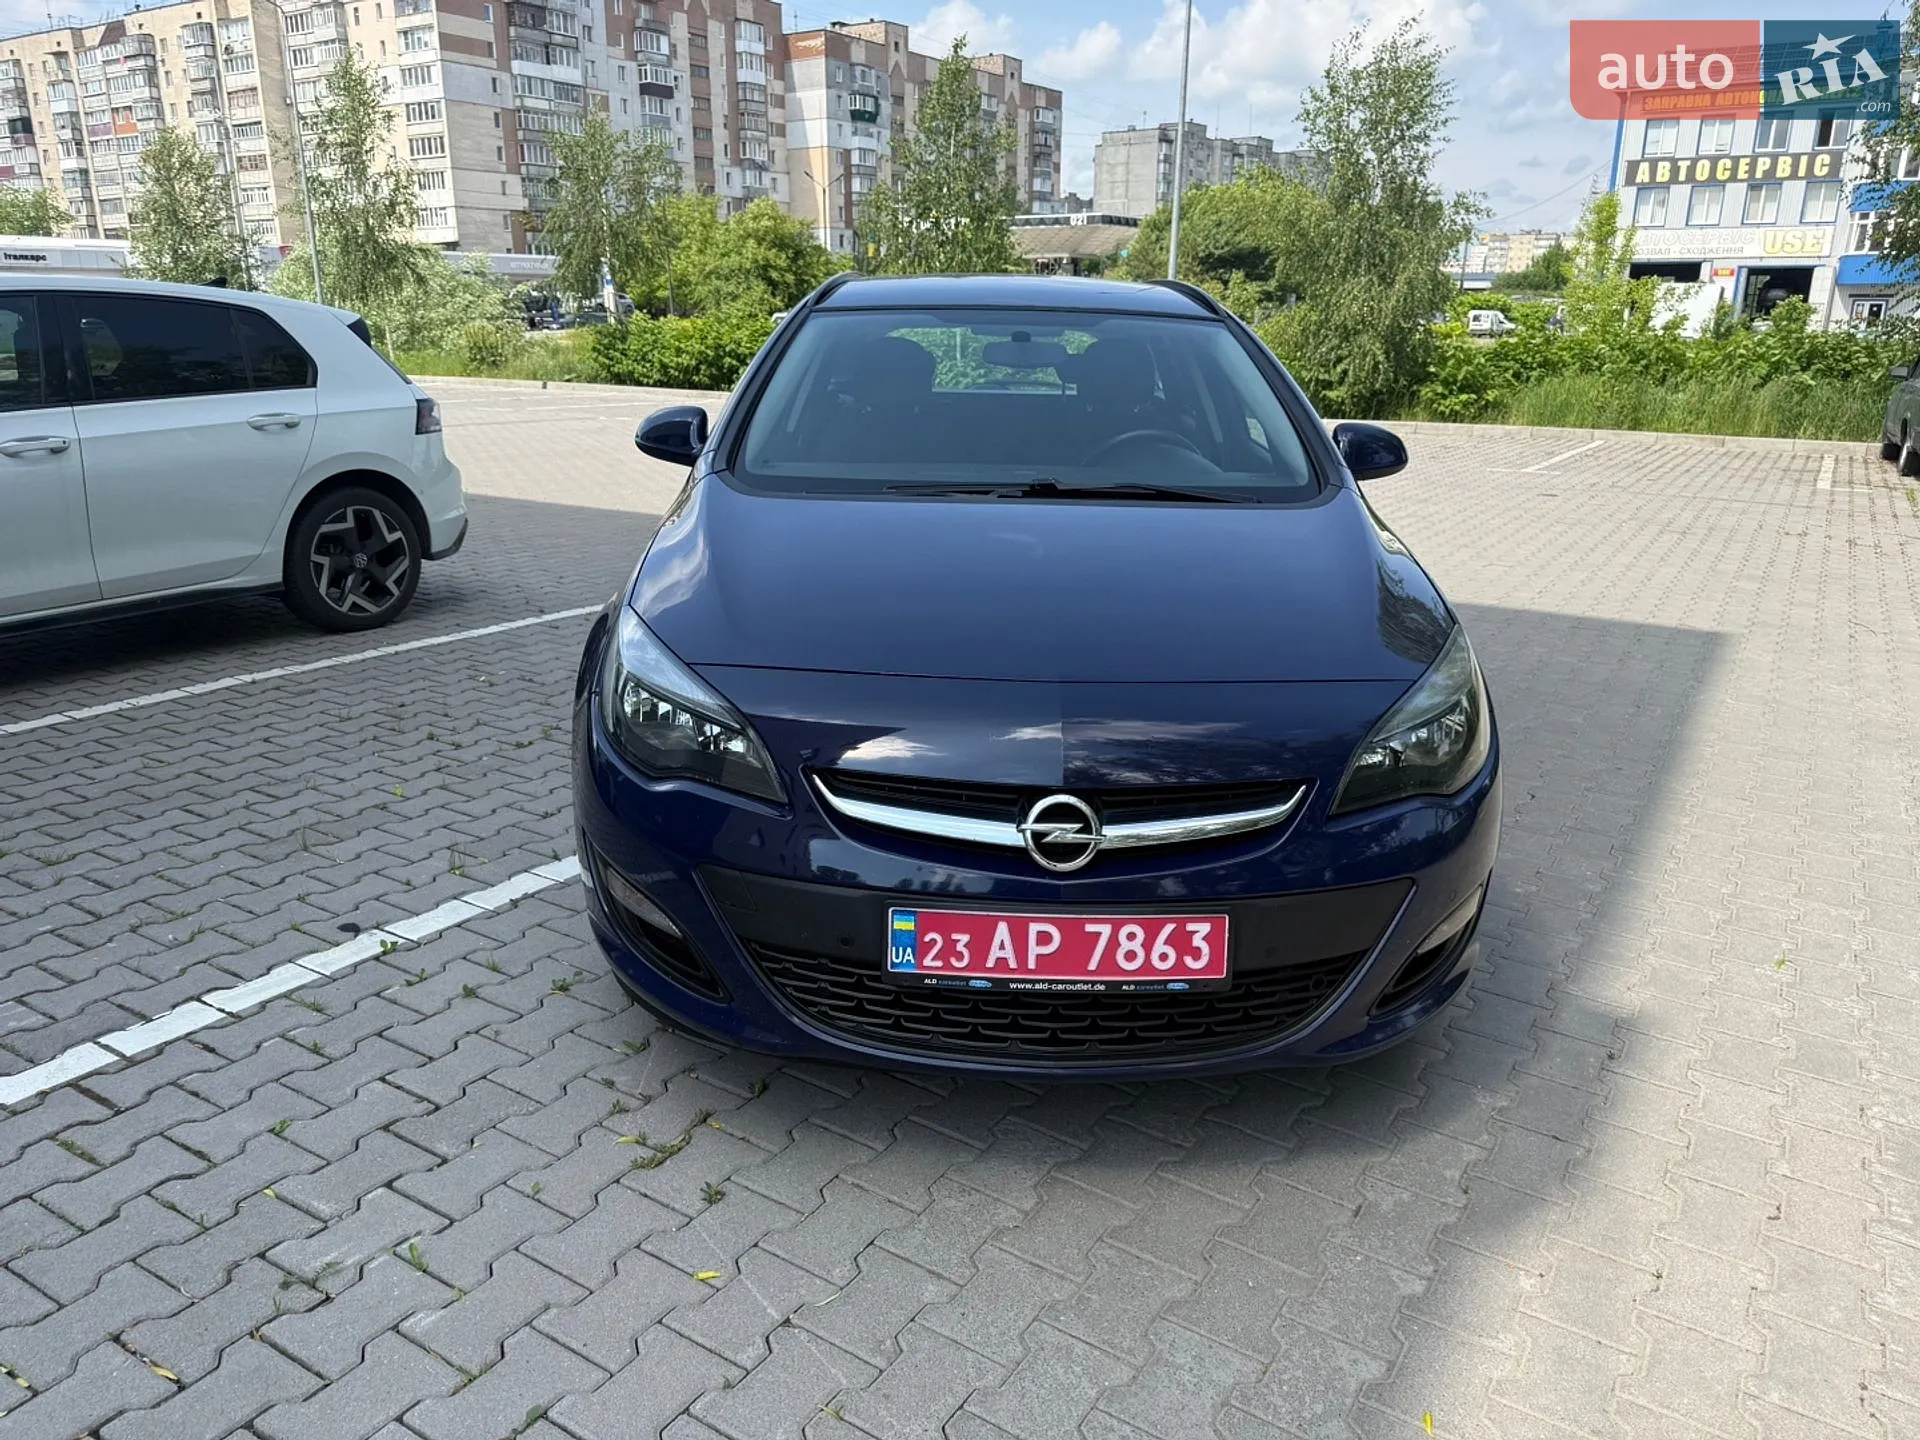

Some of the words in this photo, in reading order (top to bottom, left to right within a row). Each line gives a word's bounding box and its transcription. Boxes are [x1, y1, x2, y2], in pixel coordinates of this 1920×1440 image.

[1635, 153, 1831, 184] АВТОСЕРВІС
[1636, 229, 1756, 247] ВТОСЕРВІС
[1762, 229, 1827, 255] USE
[1634, 246, 1671, 256] ОЗВАЛ
[892, 946, 915, 964] UA
[922, 932, 971, 968] 23
[985, 921, 1062, 970] AP
[1084, 922, 1212, 971] 7863
[1009, 981, 1106, 991] www.ald-caroutlet.de
